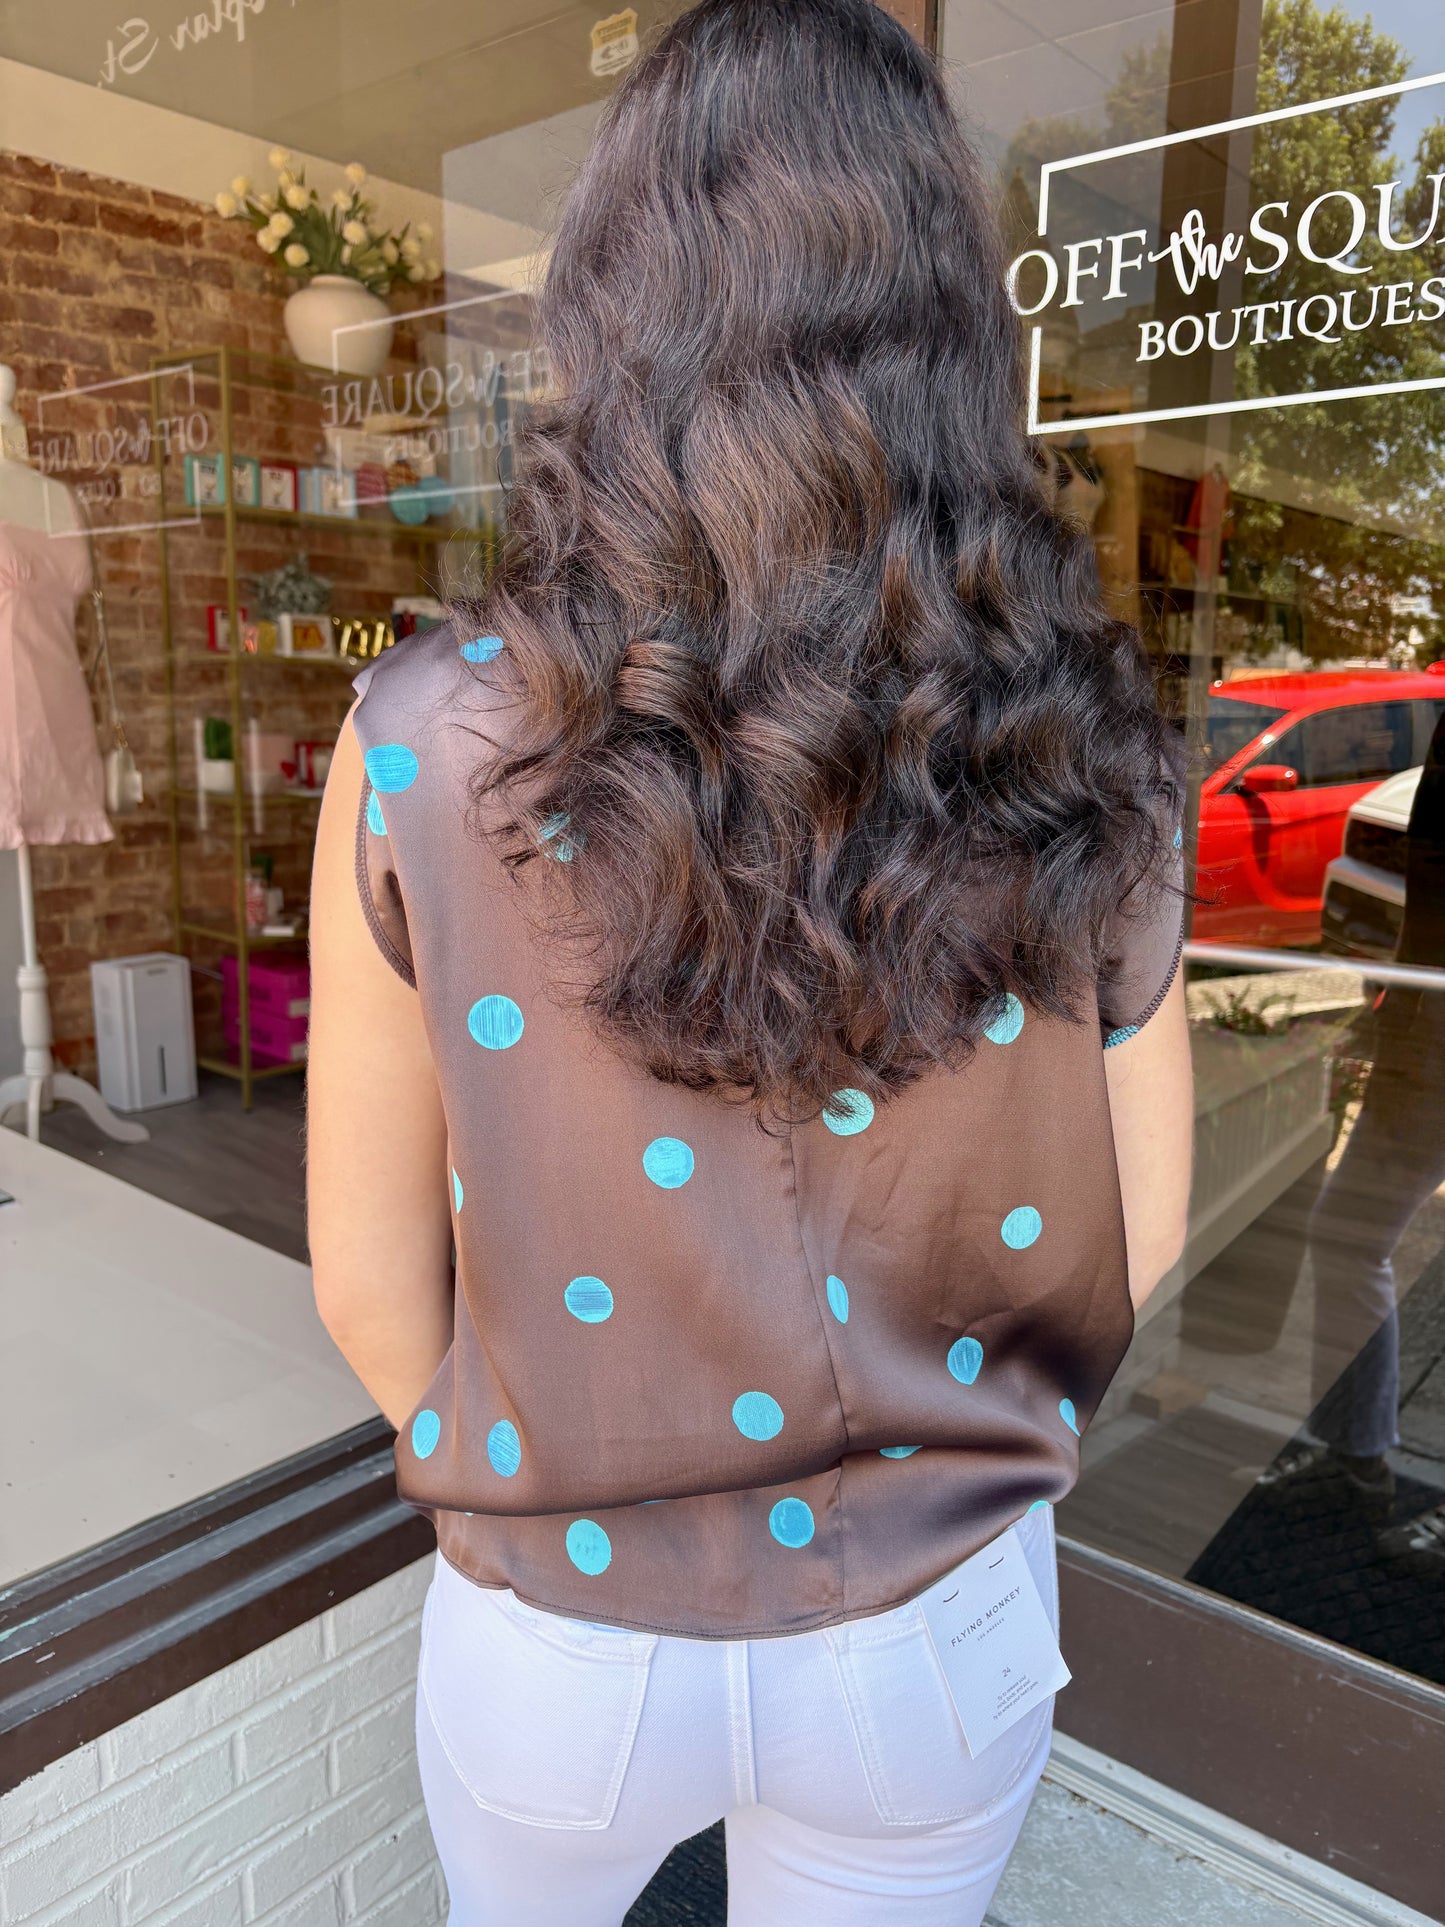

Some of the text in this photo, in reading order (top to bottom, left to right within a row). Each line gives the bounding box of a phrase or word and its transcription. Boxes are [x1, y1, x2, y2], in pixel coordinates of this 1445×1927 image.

[1005, 172, 1445, 316] OFF the SQU
[1136, 276, 1445, 363] BOUTIQUES
[951, 1586, 1021, 1647] FLYING MONKEY
